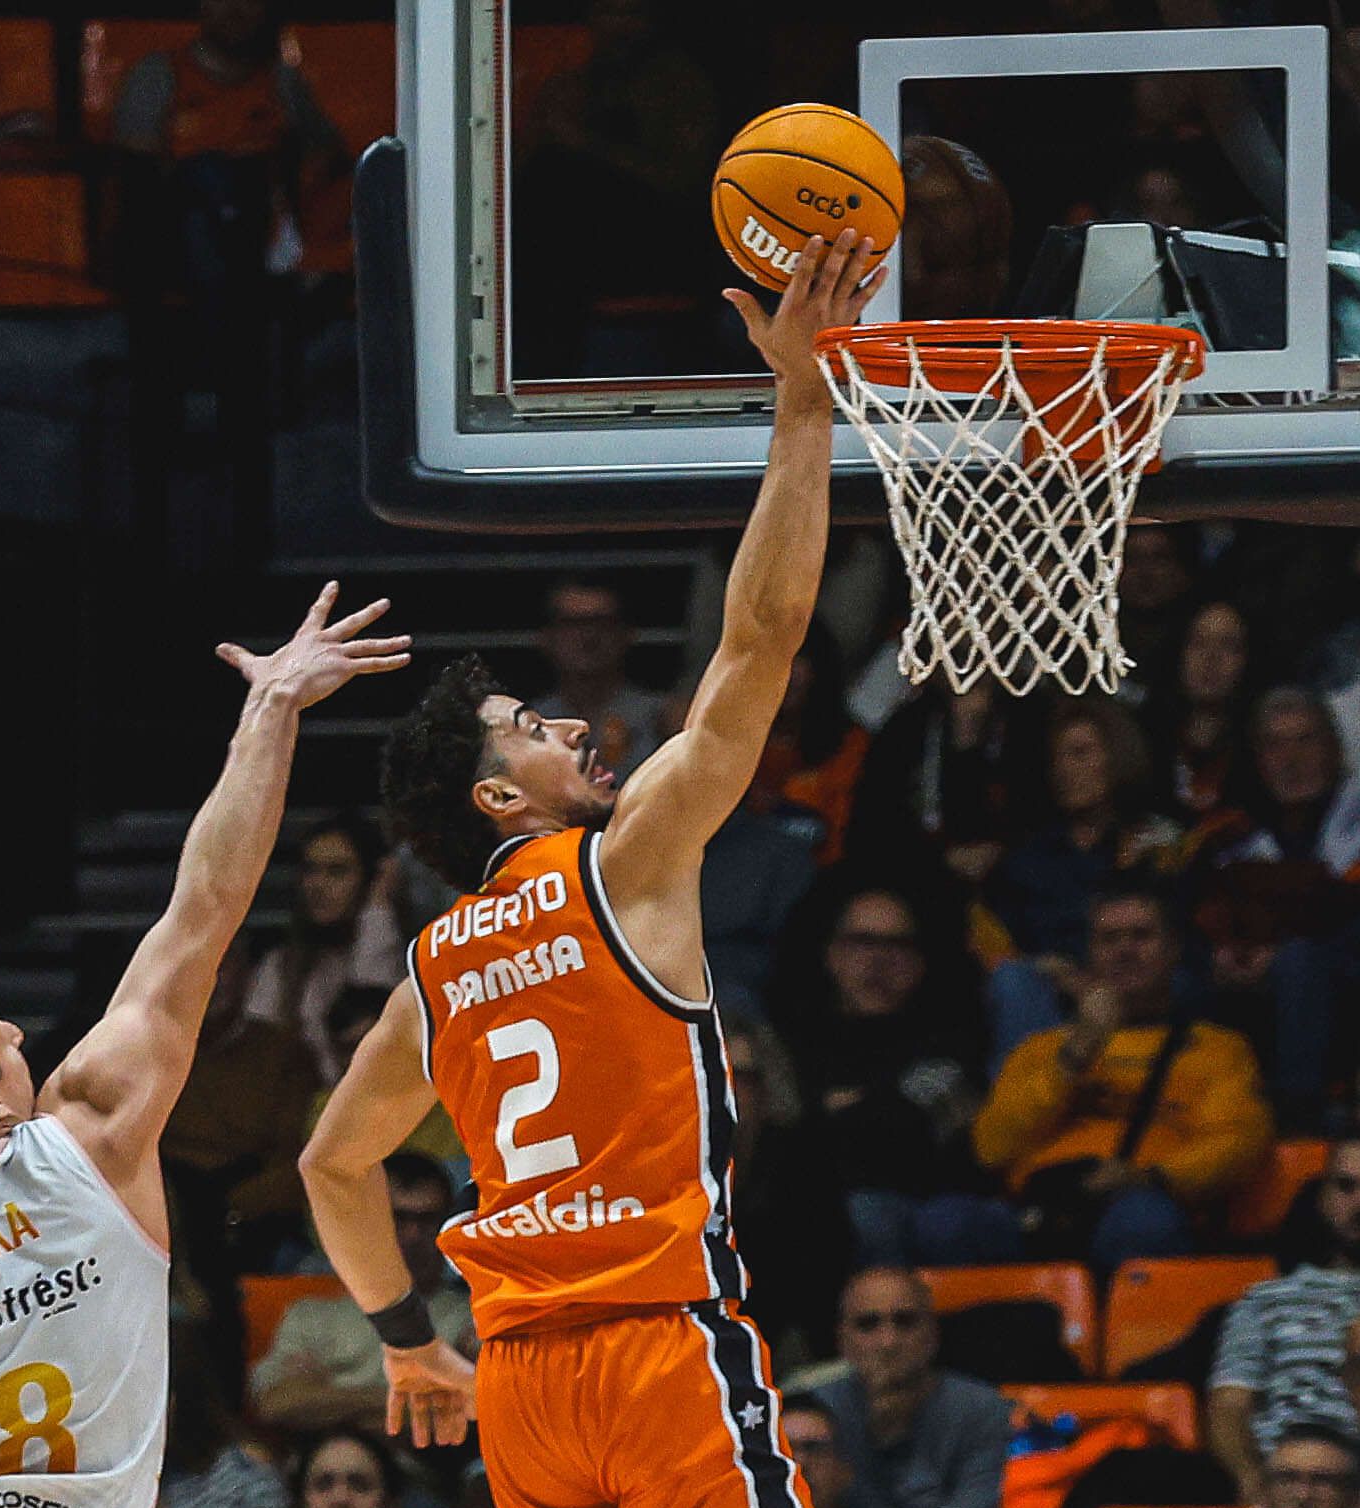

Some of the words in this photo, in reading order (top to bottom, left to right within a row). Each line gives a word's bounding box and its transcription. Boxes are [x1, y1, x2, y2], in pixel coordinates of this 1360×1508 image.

[796, 187, 845, 220] acb
[429, 871, 567, 959] PUERTO
[442, 934, 587, 1018] PAMESA
[485, 1017, 581, 1185] 2
